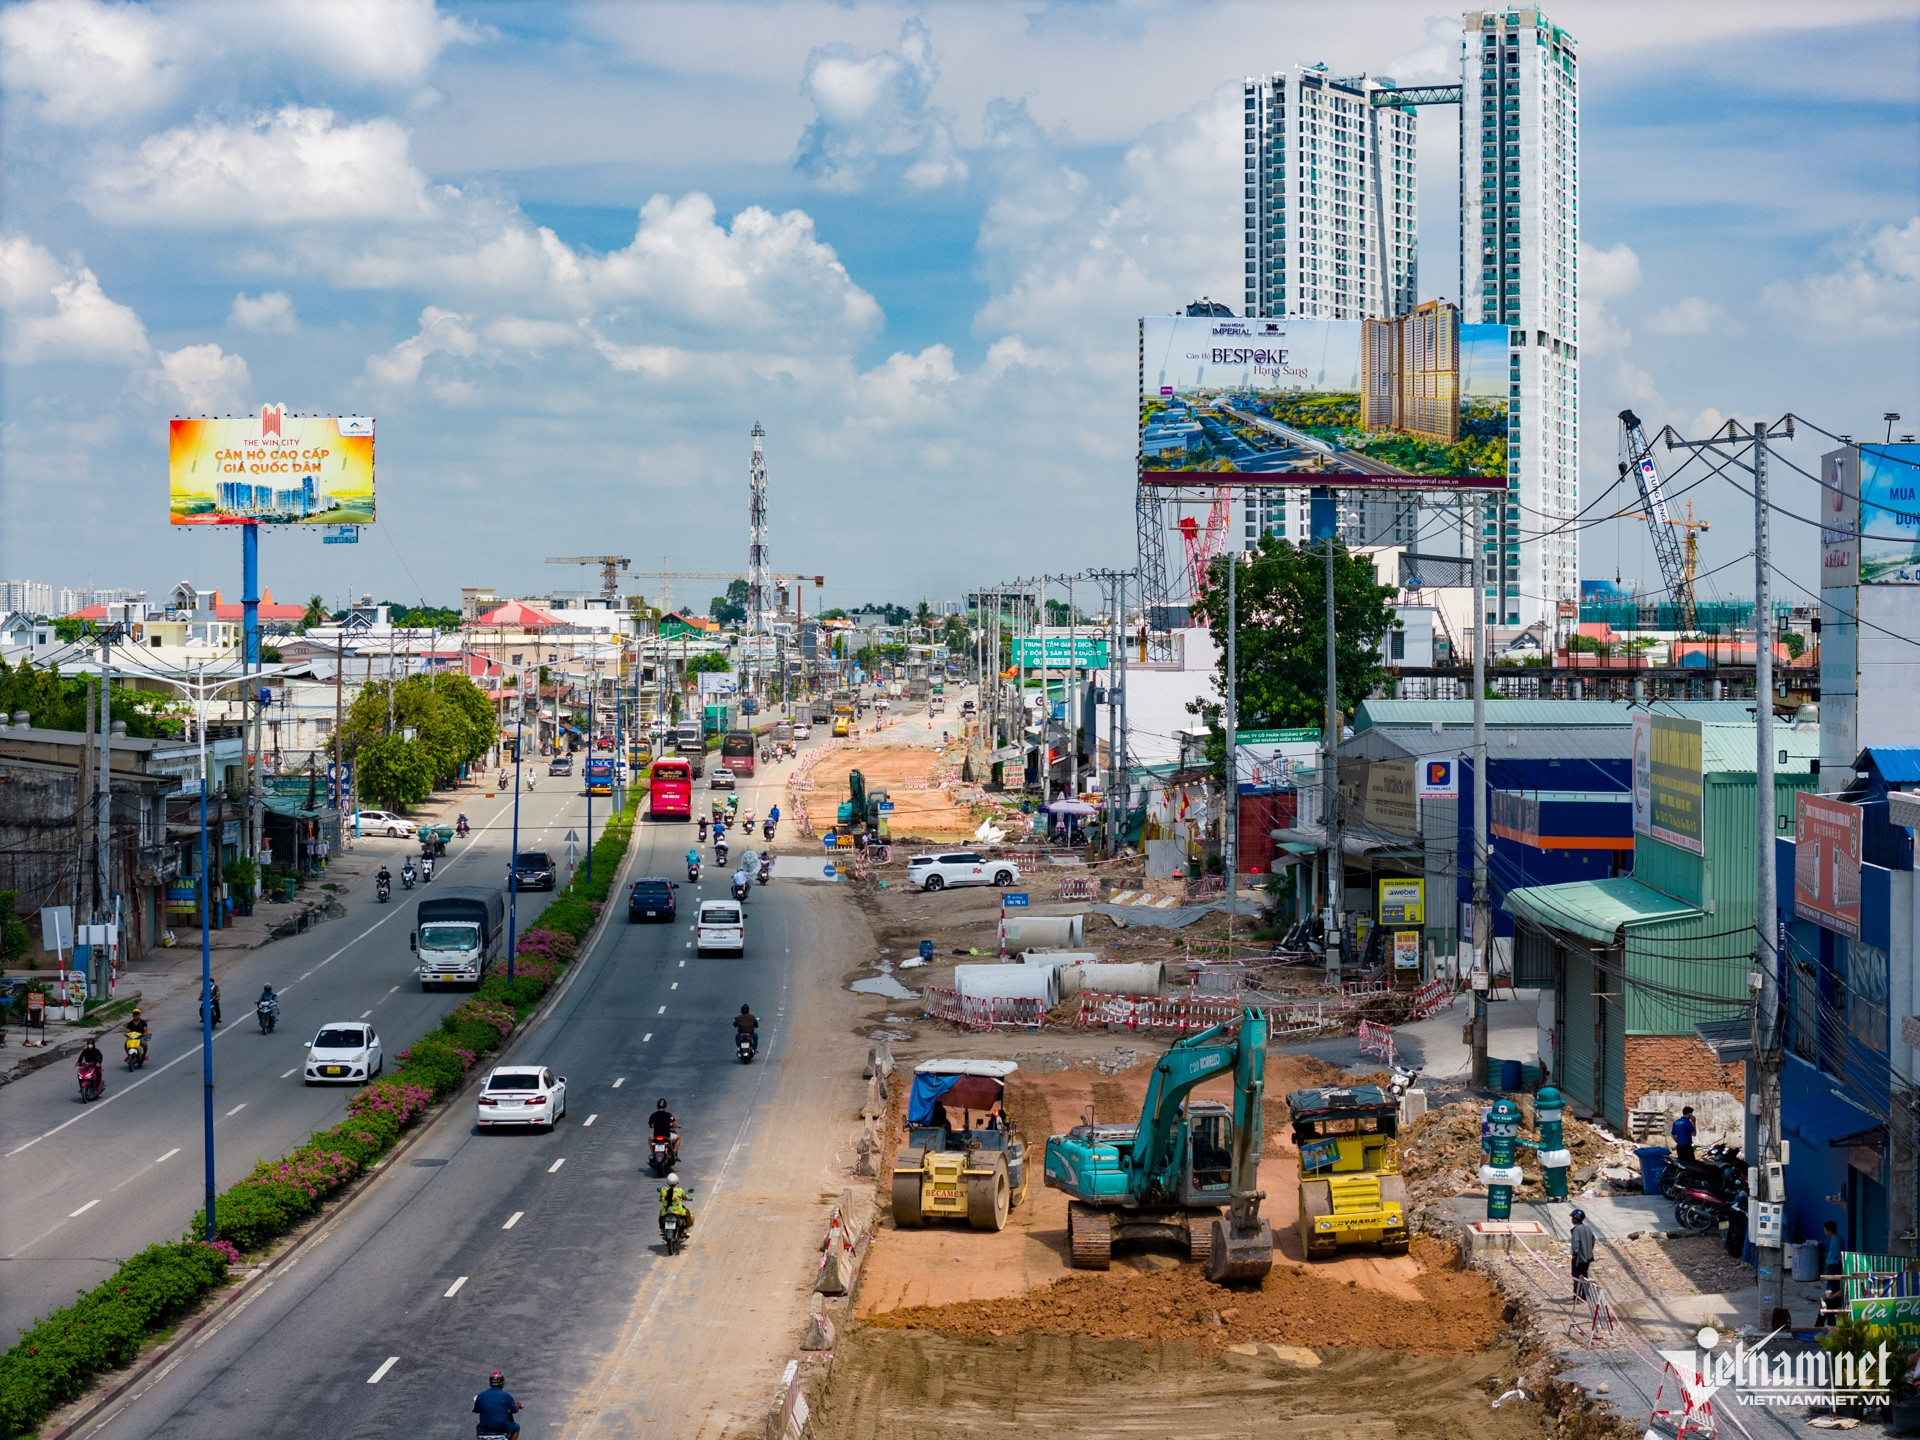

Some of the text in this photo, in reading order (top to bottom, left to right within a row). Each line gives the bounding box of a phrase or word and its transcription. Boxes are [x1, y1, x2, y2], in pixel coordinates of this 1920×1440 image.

[1212, 327, 1252, 336] IMPERIAL
[1212, 348, 1289, 364] BESPOKE
[1253, 365, 1308, 378] Hạng Sang
[243, 438, 300, 447] THE WIN CITY
[215, 447, 330, 463] CĂN HỘ CAO CẤP
[223, 460, 322, 475] GIÁ QUỐC DÂN
[1370, 477, 1459, 485] www.khaihoanimperial.com.vn
[1889, 487, 1916, 501] MUA
[1393, 888, 1417, 896] weber
[1199, 1053, 1221, 1070] KOBELCO
[925, 1189, 965, 1198] BECAMEX
[1860, 1301, 1888, 1321] Cà
